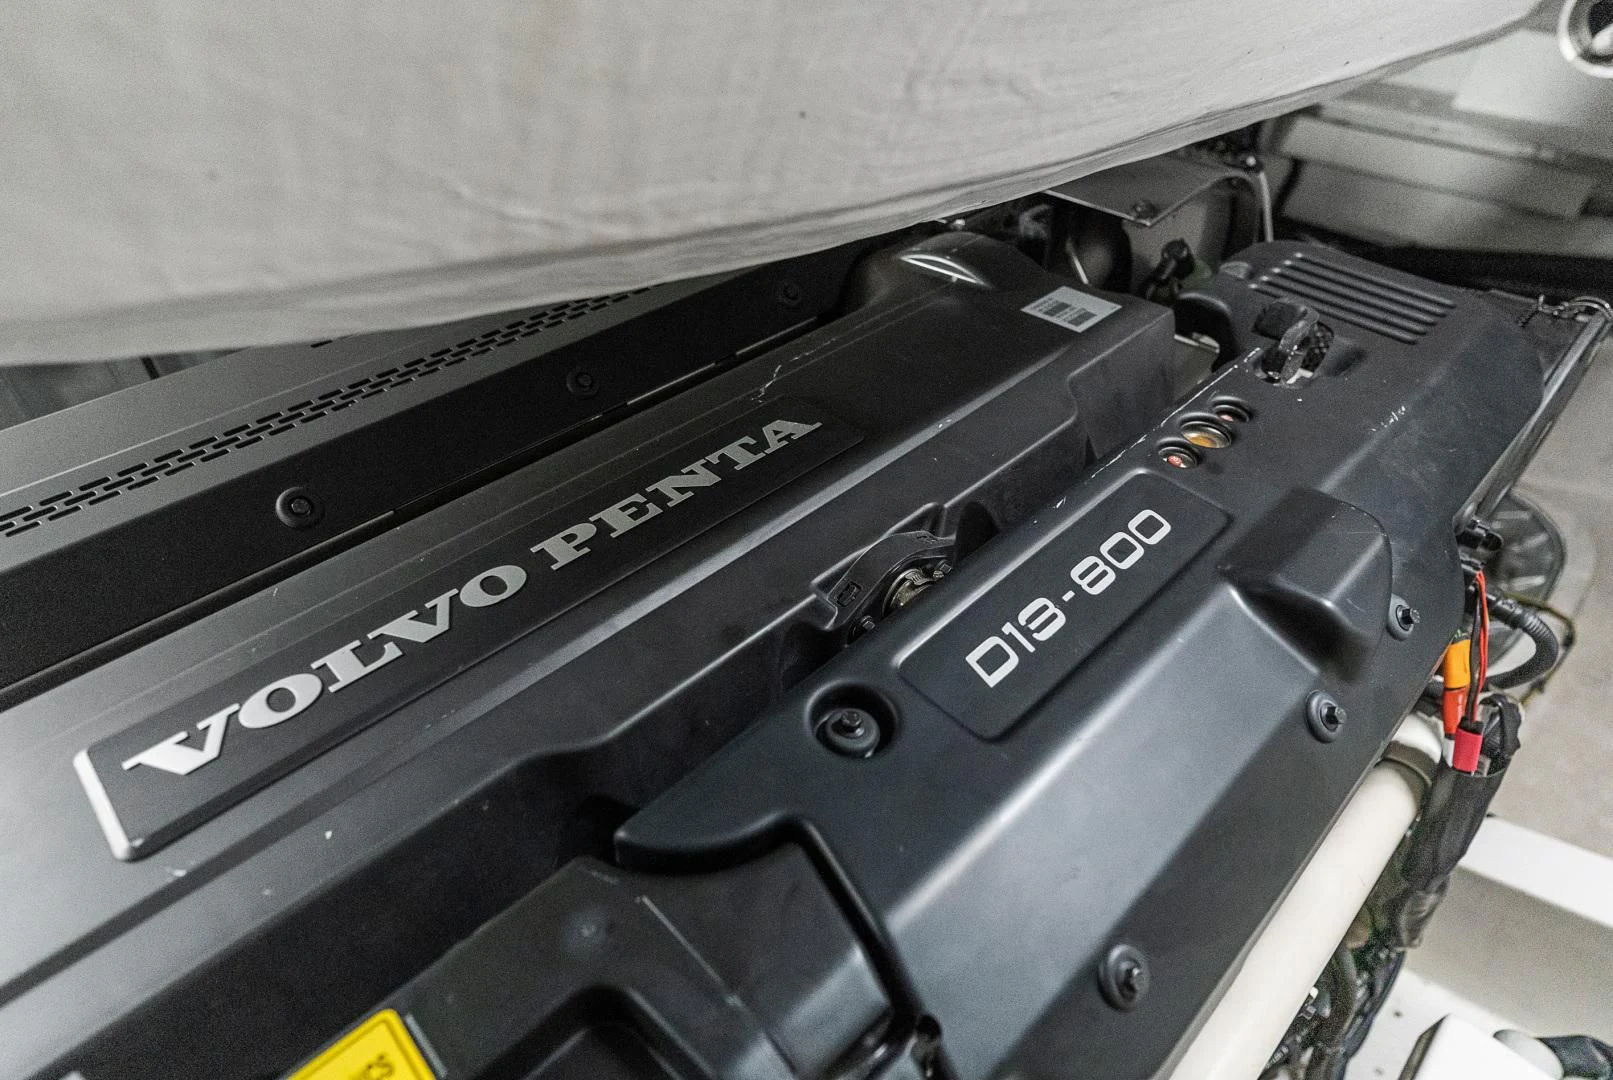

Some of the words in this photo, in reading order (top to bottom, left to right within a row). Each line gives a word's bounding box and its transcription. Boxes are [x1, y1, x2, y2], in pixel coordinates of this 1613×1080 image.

[122, 564, 527, 775] VOLVO
[530, 419, 822, 570] PENTA
[965, 509, 1172, 688] D13-800
